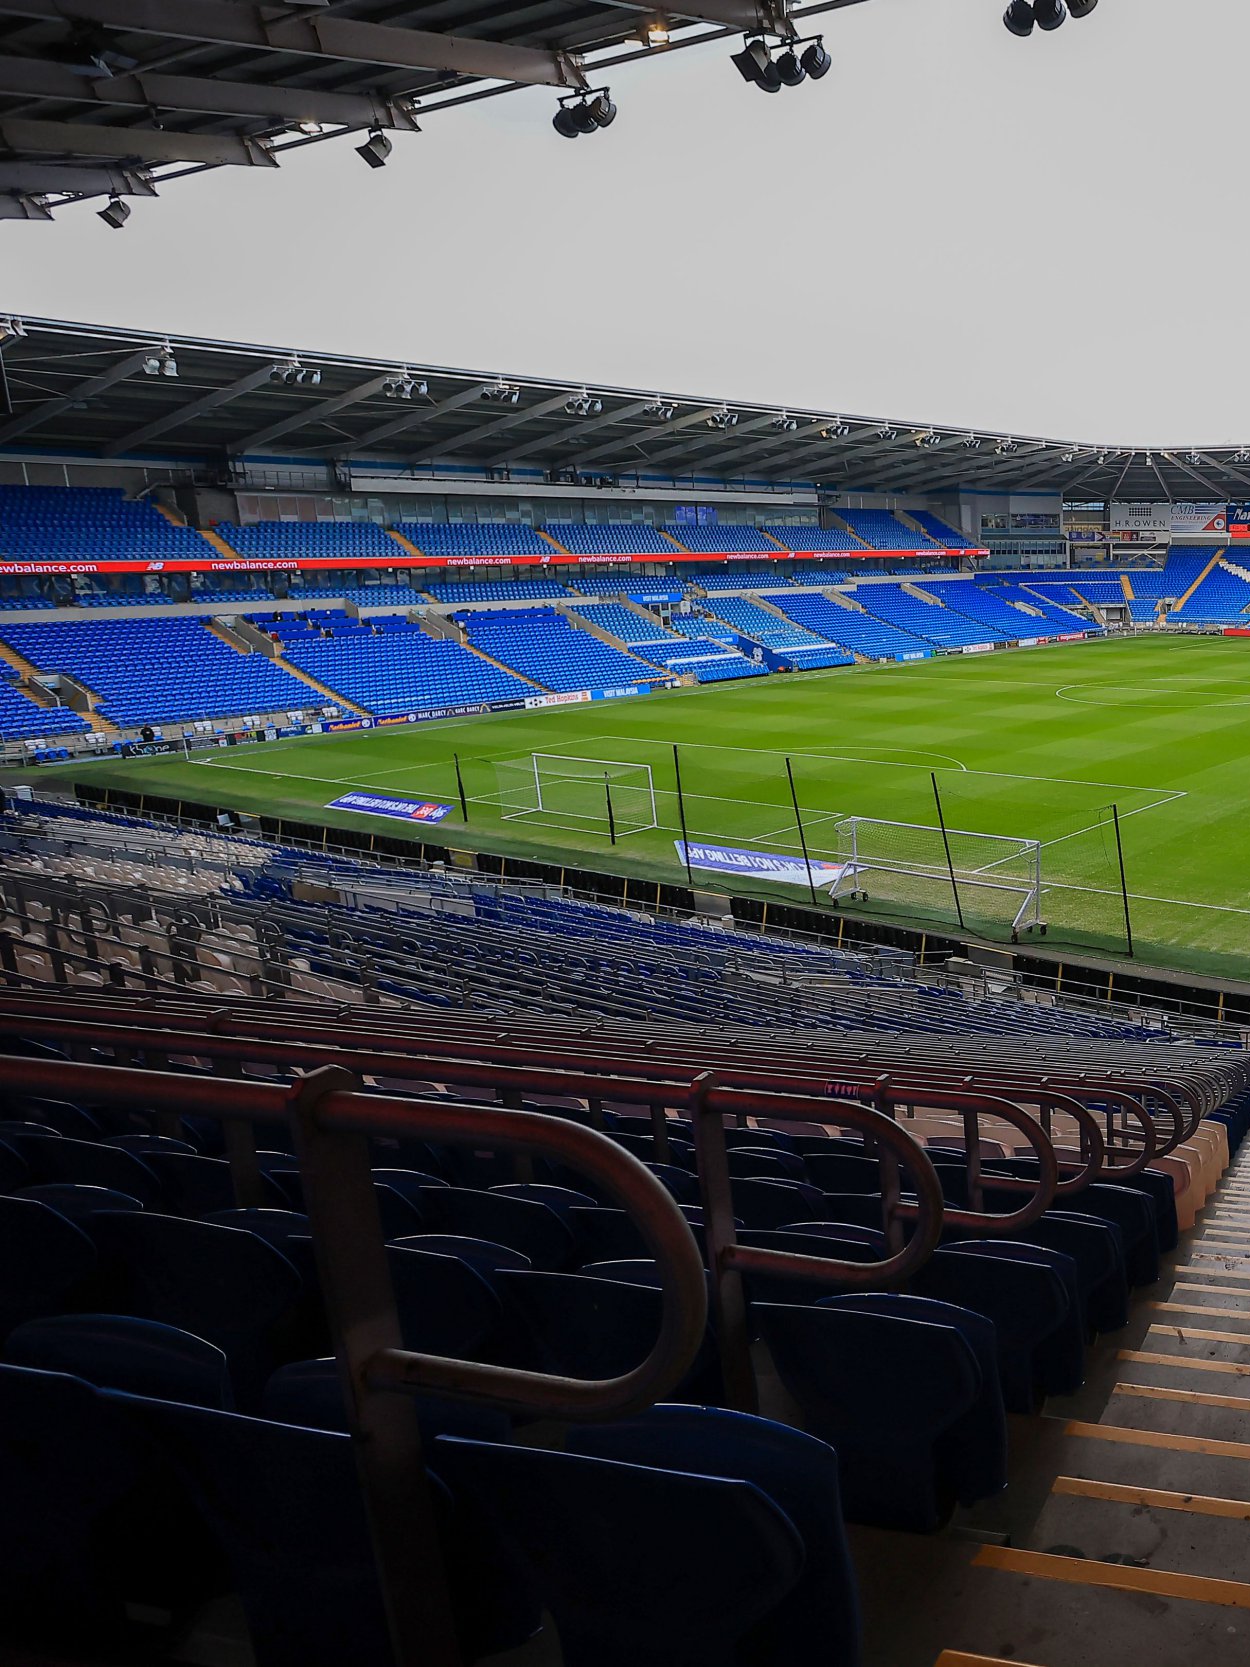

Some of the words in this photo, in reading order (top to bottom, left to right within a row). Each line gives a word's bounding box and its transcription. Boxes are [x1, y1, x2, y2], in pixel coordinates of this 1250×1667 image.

[1170, 505, 1195, 514] CMB
[447, 557, 511, 566] newbalance.com
[578, 555, 632, 563] newbalance.com
[211, 561, 298, 570] newbalance.com
[603, 688, 616, 698] VISIT
[545, 696, 556, 704] Ted
[556, 693, 579, 703] Hopkins
[466, 705, 480, 713] DARCY
[417, 710, 431, 719] MARC
[431, 709, 447, 719] DARCY
[705, 849, 749, 866] BETTING
